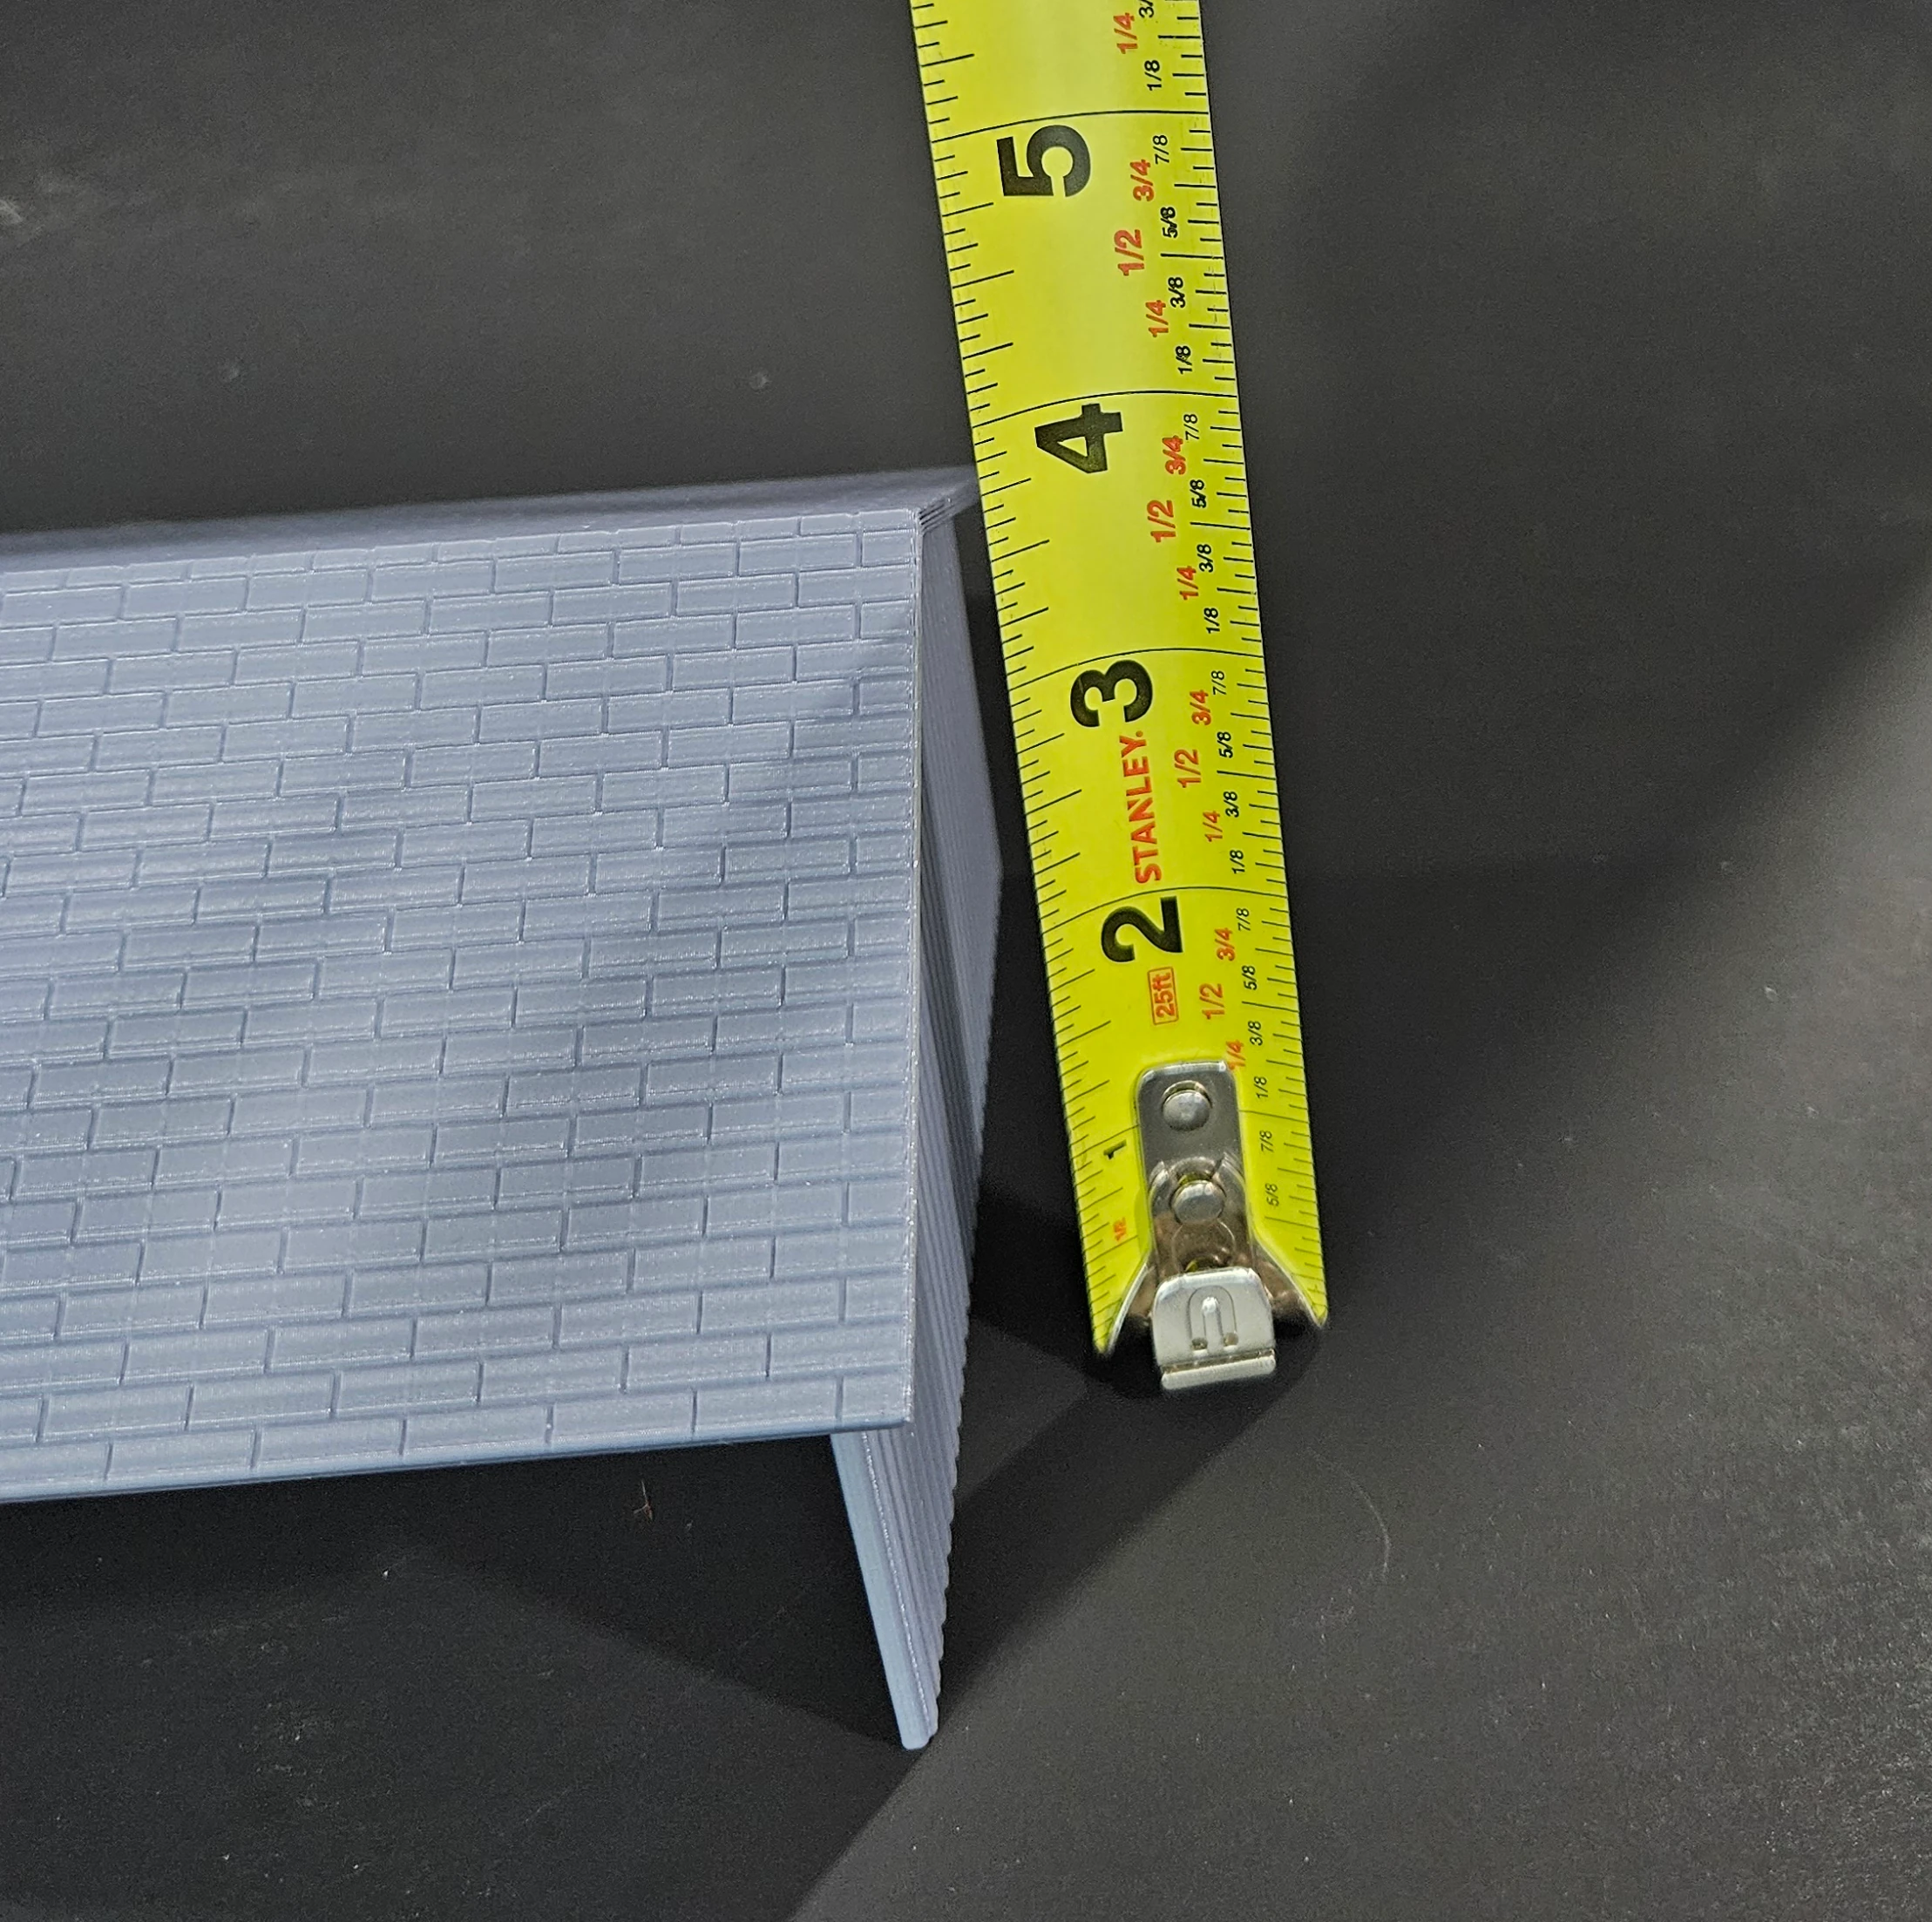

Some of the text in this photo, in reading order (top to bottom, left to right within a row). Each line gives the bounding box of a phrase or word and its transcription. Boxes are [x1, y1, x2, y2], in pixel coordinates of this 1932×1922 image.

[1139, 0, 1155, 17] 3/
[1114, 12, 1138, 54] 1/4
[1144, 59, 1162, 91] 1/8
[996, 125, 1091, 197] 5
[1153, 135, 1169, 164] 7/8
[1130, 160, 1155, 201] 3/4
[1160, 206, 1178, 238] 5/8
[1114, 229, 1145, 276] 1/2
[1168, 276, 1186, 308] 3/8
[1146, 300, 1169, 337] 1/4
[1176, 345, 1193, 374] 1/8
[1034, 404, 1123, 473] 4
[1183, 413, 1200, 440] 7/8
[1163, 436, 1186, 475] 3/4
[1190, 479, 1207, 508] 5/8
[1147, 500, 1176, 542] 1/2
[1196, 544, 1214, 573] 3/8
[1176, 566, 1199, 600] 1/4
[1203, 608, 1220, 634] 1/8
[1070, 660, 1153, 728] 3
[1211, 670, 1227, 696] 7/8
[1190, 689, 1211, 725] 3/4
[1217, 731, 1234, 758] 5/8
[1174, 749, 1202, 788] 1/2
[1224, 791, 1240, 818] 3/8
[1203, 811, 1223, 842] 1/4
[1230, 850, 1244, 874] 1/8
[1101, 895, 1183, 963] 2
[1237, 907, 1251, 932] 7/8
[1215, 927, 1236, 961] 3/4
[1242, 965, 1257, 990] 5/8
[1153, 972, 1176, 1018] 25ft
[1199, 983, 1225, 1020] 1/2
[1248, 1021, 1264, 1046] 3/8
[1226, 1040, 1246, 1070] 1/4
[1254, 1076, 1268, 1098] 1/8
[1104, 1140, 1127, 1159] 1
[1261, 1131, 1273, 1153] 7/8
[1265, 1183, 1279, 1206] 5/8
